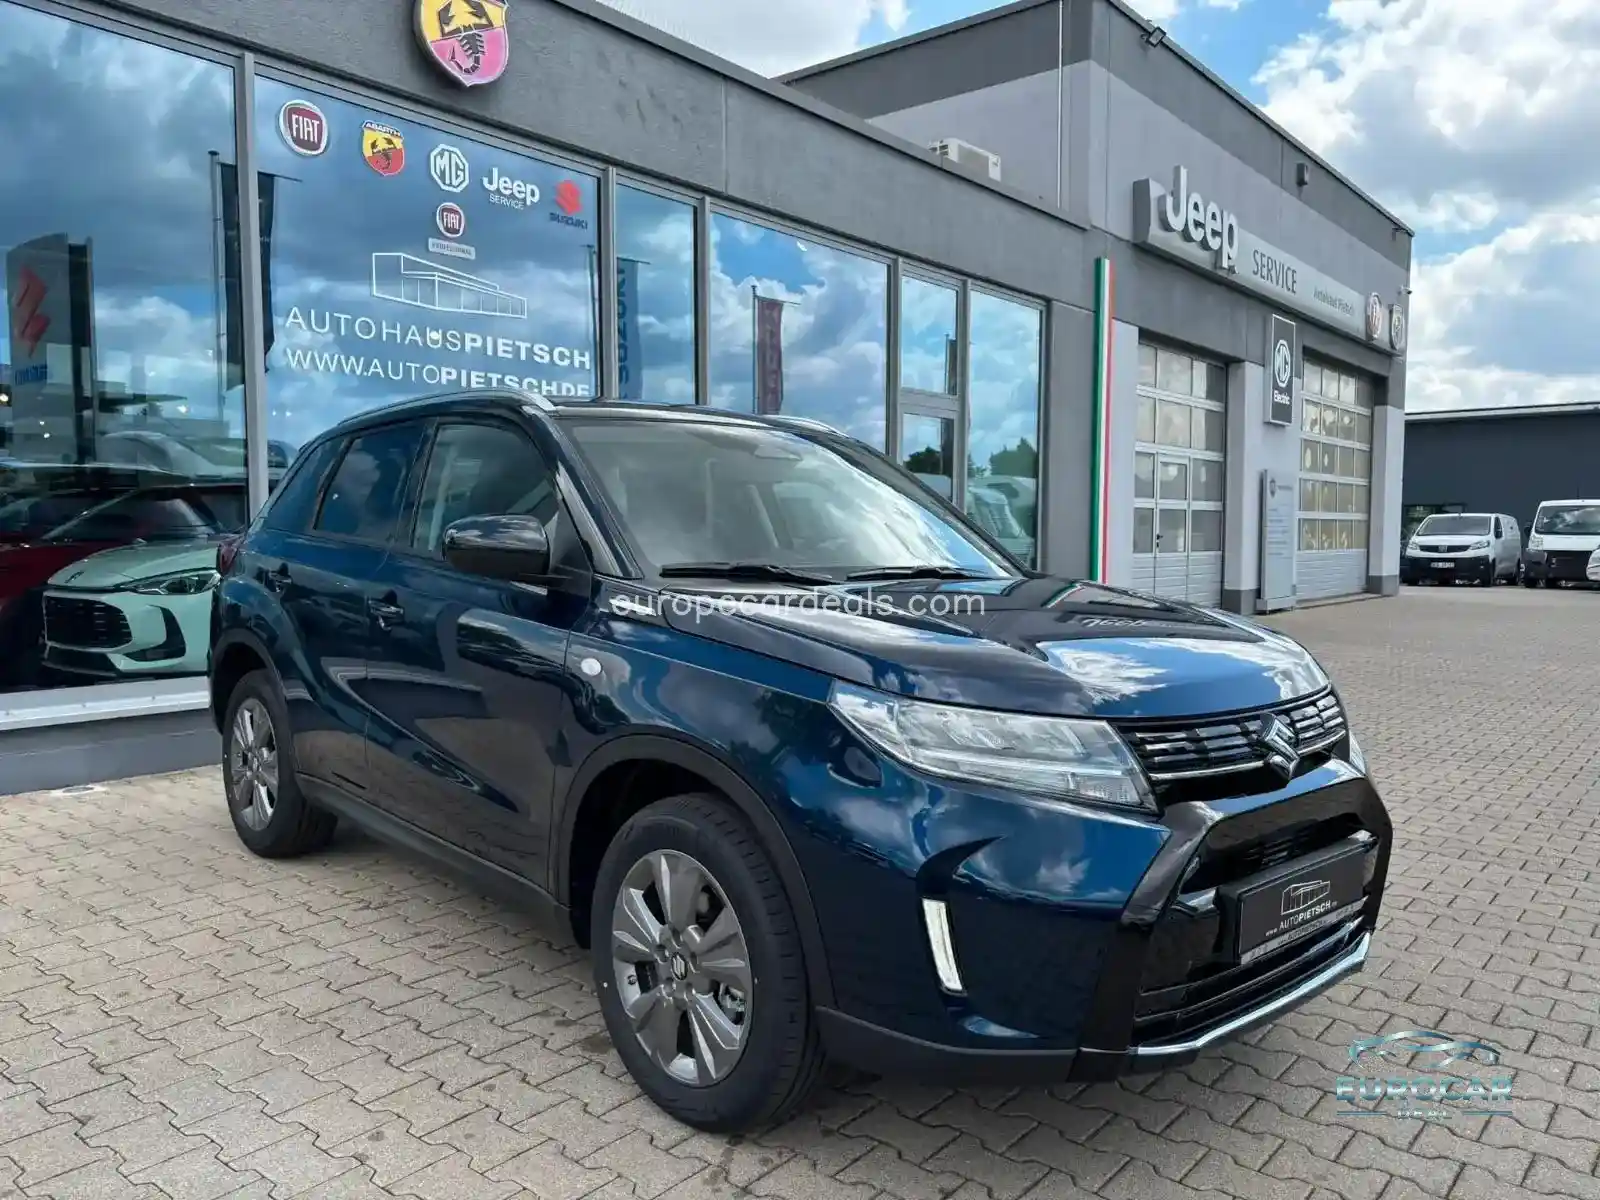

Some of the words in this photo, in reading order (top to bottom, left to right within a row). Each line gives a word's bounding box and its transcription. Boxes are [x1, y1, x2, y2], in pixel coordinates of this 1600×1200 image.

[292, 114, 320, 144] FIAT
[434, 150, 465, 187] MG
[482, 167, 540, 206] Jeep
[489, 193, 525, 210] SERVICE
[1161, 165, 1239, 270] Jeep
[443, 211, 460, 230] FIAT
[1252, 249, 1297, 294] SERVICE
